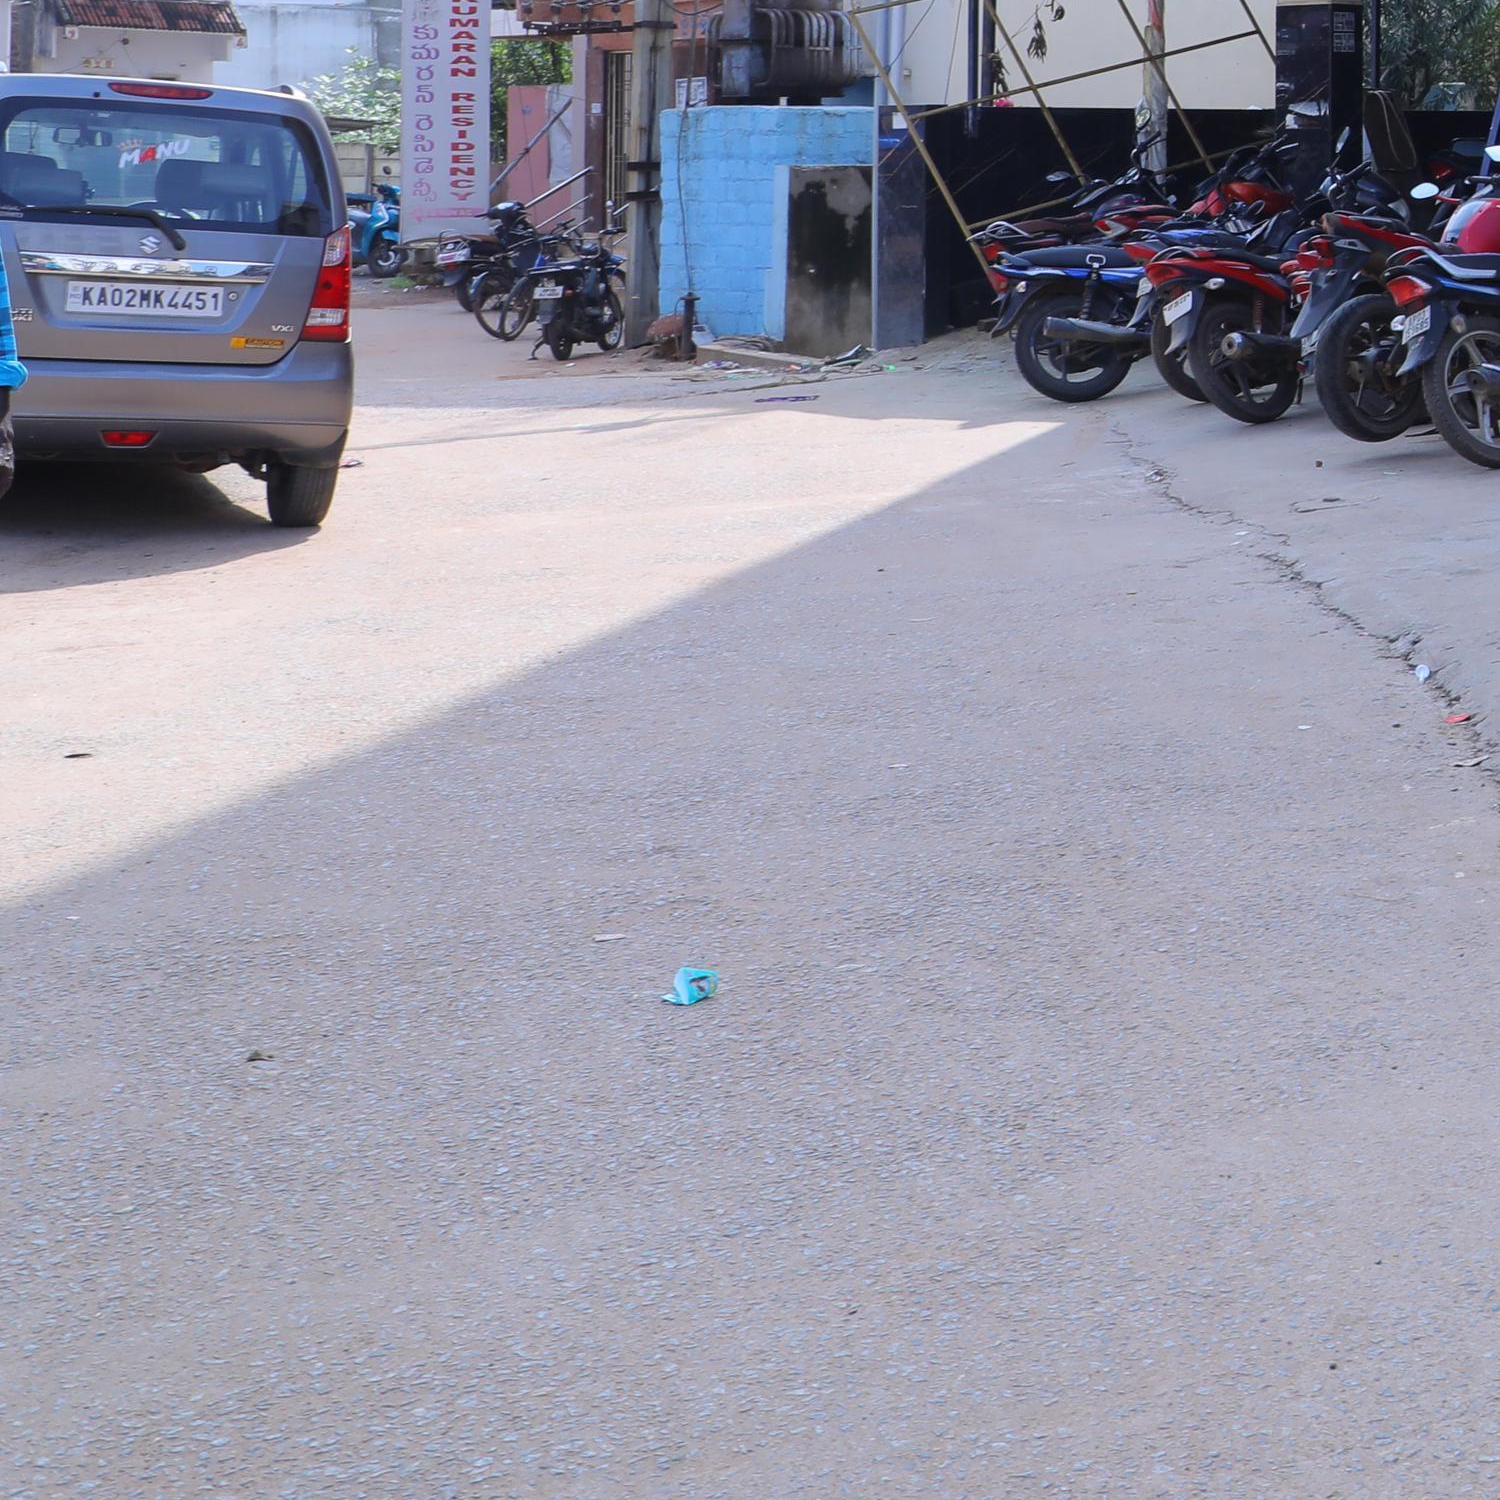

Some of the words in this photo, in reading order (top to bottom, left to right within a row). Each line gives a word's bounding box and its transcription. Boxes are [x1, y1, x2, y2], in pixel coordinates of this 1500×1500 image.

[118, 138, 191, 169] MANU
[449, 93, 476, 201] RESIDENCY
[82, 286, 220, 312] KA02MK4451
